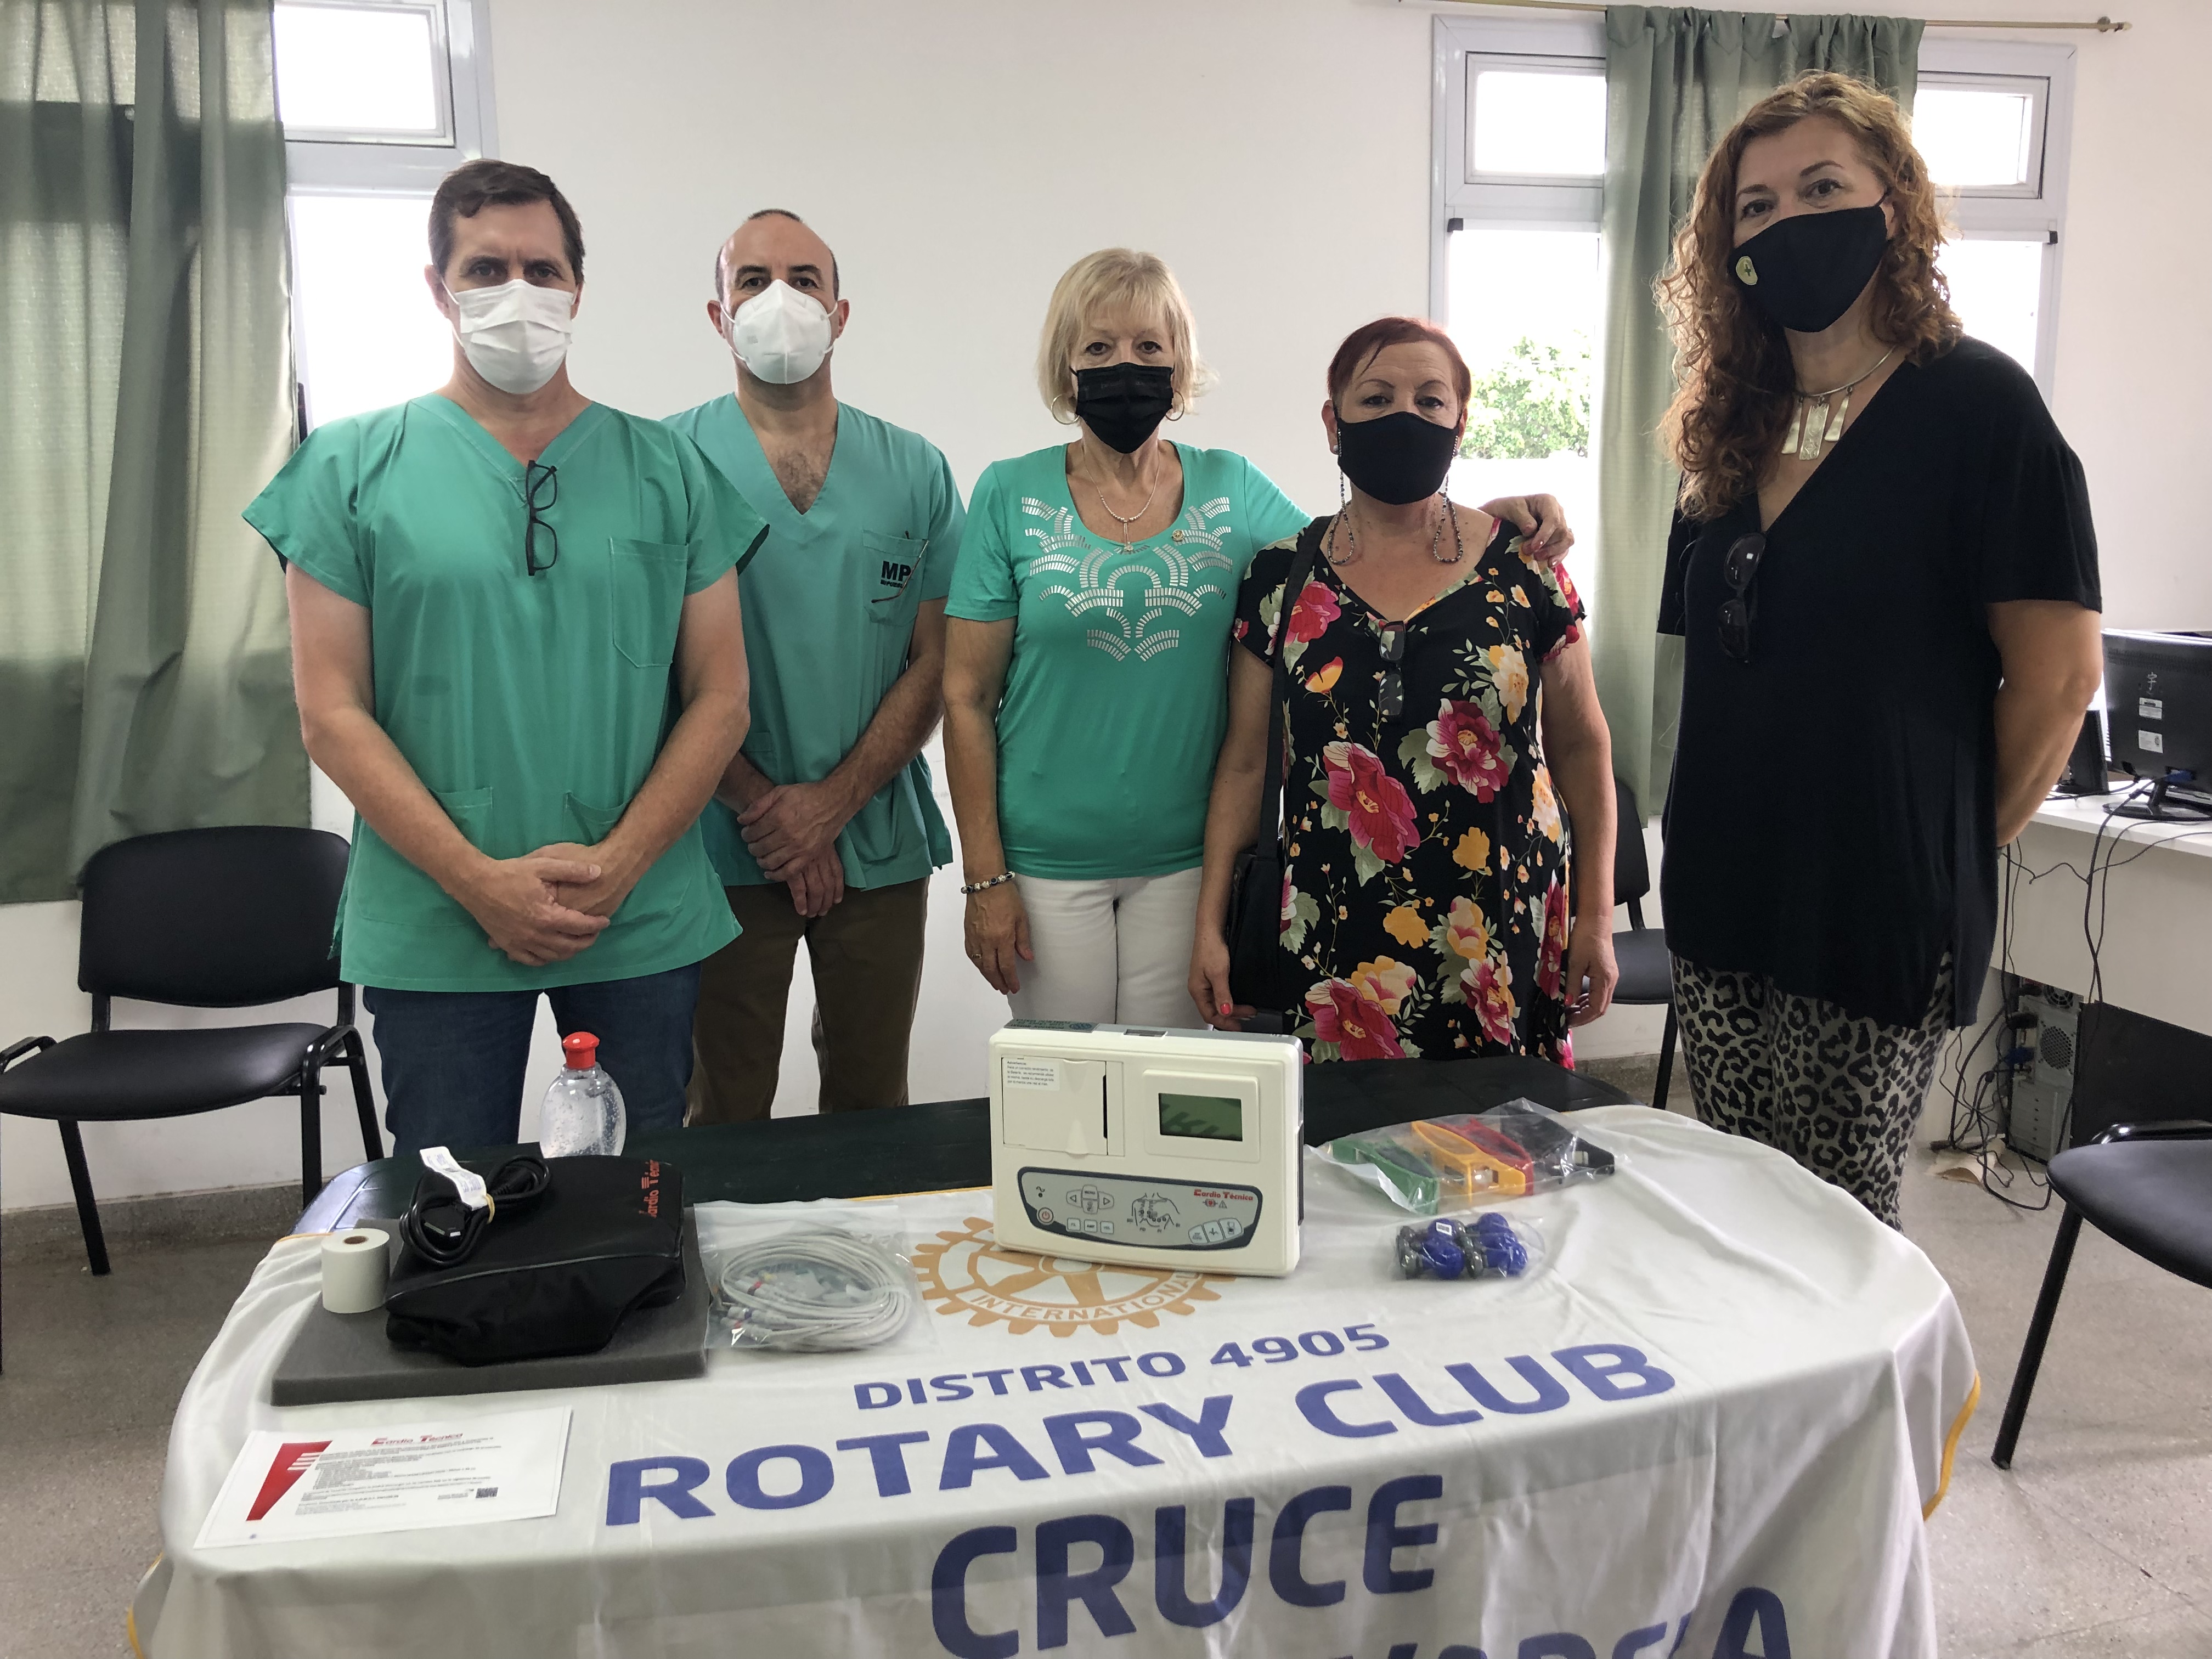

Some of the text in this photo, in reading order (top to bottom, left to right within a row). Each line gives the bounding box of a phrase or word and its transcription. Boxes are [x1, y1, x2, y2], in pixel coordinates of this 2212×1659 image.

[881, 561, 912, 582] MP
[1193, 1188, 1221, 1199] Cardio
[970, 1272, 1199, 1322] INTERNATIONAL
[854, 1323, 1390, 1410] DISTRITO 4905
[605, 1394, 1234, 1526] ROTARY
[1295, 1343, 1676, 1439] CLUB
[931, 1474, 1443, 1659] CRUCE
